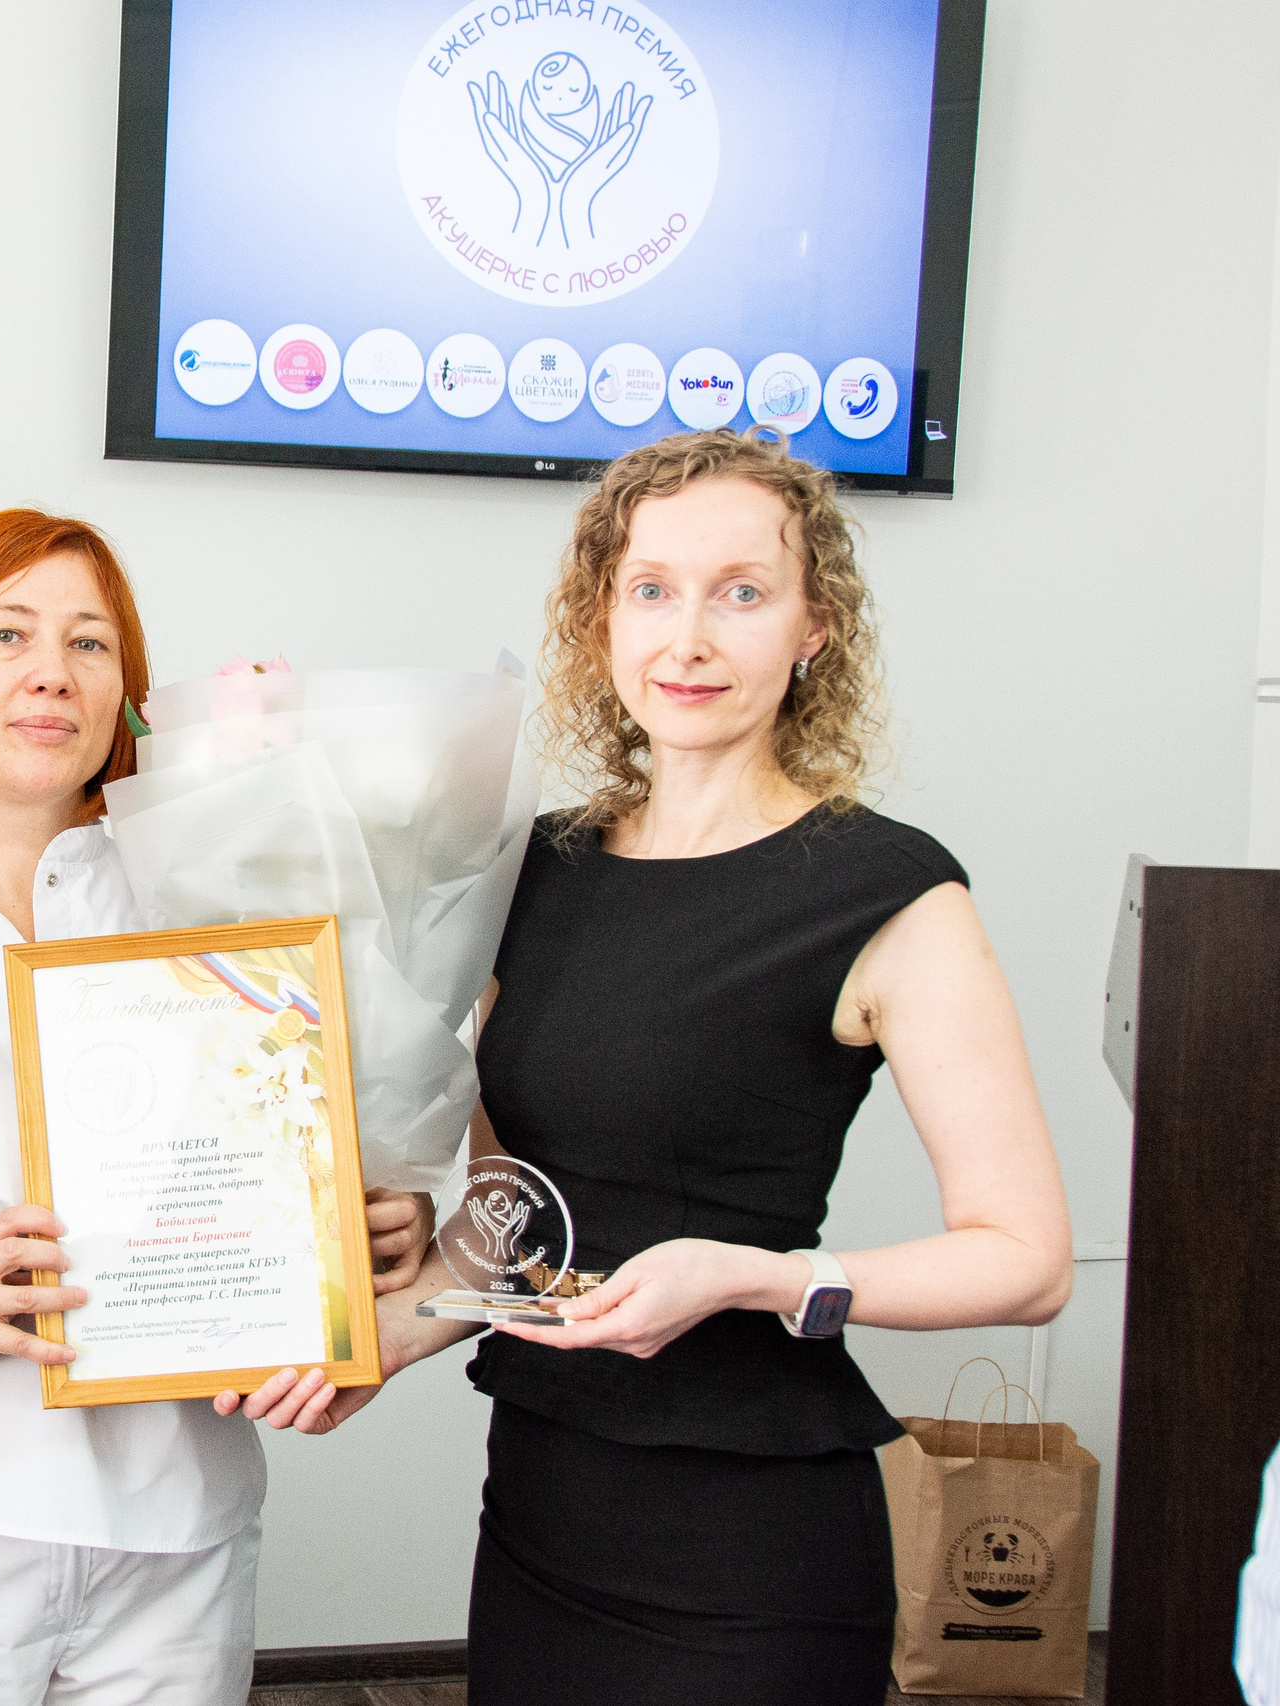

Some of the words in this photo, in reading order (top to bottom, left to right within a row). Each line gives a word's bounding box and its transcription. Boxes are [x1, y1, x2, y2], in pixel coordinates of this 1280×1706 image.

[428, 0, 595, 78] ЕЖЕГОДНАЯ
[601, 6, 697, 100] ПРЕМИЯ
[421, 195, 537, 291] АКУШЕРКЕ
[543, 274, 559, 293] С
[568, 213, 687, 293] ЛЮБОВЬЮ
[522, 374, 572, 387] СКАЖИ
[626, 368, 655, 378] ДЕВЯТЬ
[515, 386, 578, 398] ЦВЕТАМИ
[625, 380, 660, 390] МЕСЯЦЕВ
[545, 462, 556, 471] LG
[56, 978, 242, 1024] Благодарность
[141, 1137, 219, 1154] ВРУЧАЕТСЯ
[171, 1151, 221, 1166] народной
[223, 1150, 263, 1162] премии
[219, 1177, 264, 1191] доброту
[454, 1171, 507, 1200] ЕЖЕГОДНАЯ
[509, 1175, 545, 1209] ПРЕМИЯ
[147, 1204, 153, 1212] и
[156, 1198, 223, 1213] сердечность
[155, 1213, 218, 1228] Бобылевой
[123, 1235, 189, 1248] Анастасии
[192, 1229, 252, 1244] Борисовне
[128, 1251, 181, 1265] Акушерке
[183, 1246, 250, 1260] акушерского
[455, 1237, 497, 1273] АКУШЕРКЕ
[497, 1266, 505, 1275] С
[505, 1246, 546, 1275] ЛЮБОВЬЮ
[95, 1266, 185, 1281] обсервационного
[187, 1260, 245, 1274] отделения
[248, 1255, 287, 1269] КГБУЗ
[122, 1276, 217, 1293] «Перинатальный
[220, 1274, 261, 1287] центр»
[490, 1280, 515, 1292] 2025
[104, 1298, 138, 1308] имени
[140, 1293, 205, 1308] профессора.
[208, 1289, 229, 1300] Г.С.
[232, 1286, 282, 1299] Постола
[944, 1515, 1010, 1594] ДАЛЬНЕВОСТОЧНЫЕ
[1013, 1518, 1055, 1597] МОРЕПРОДУКТЫ
[963, 1570, 995, 1585] МОРЕ
[999, 1572, 1036, 1586] КРАБА
